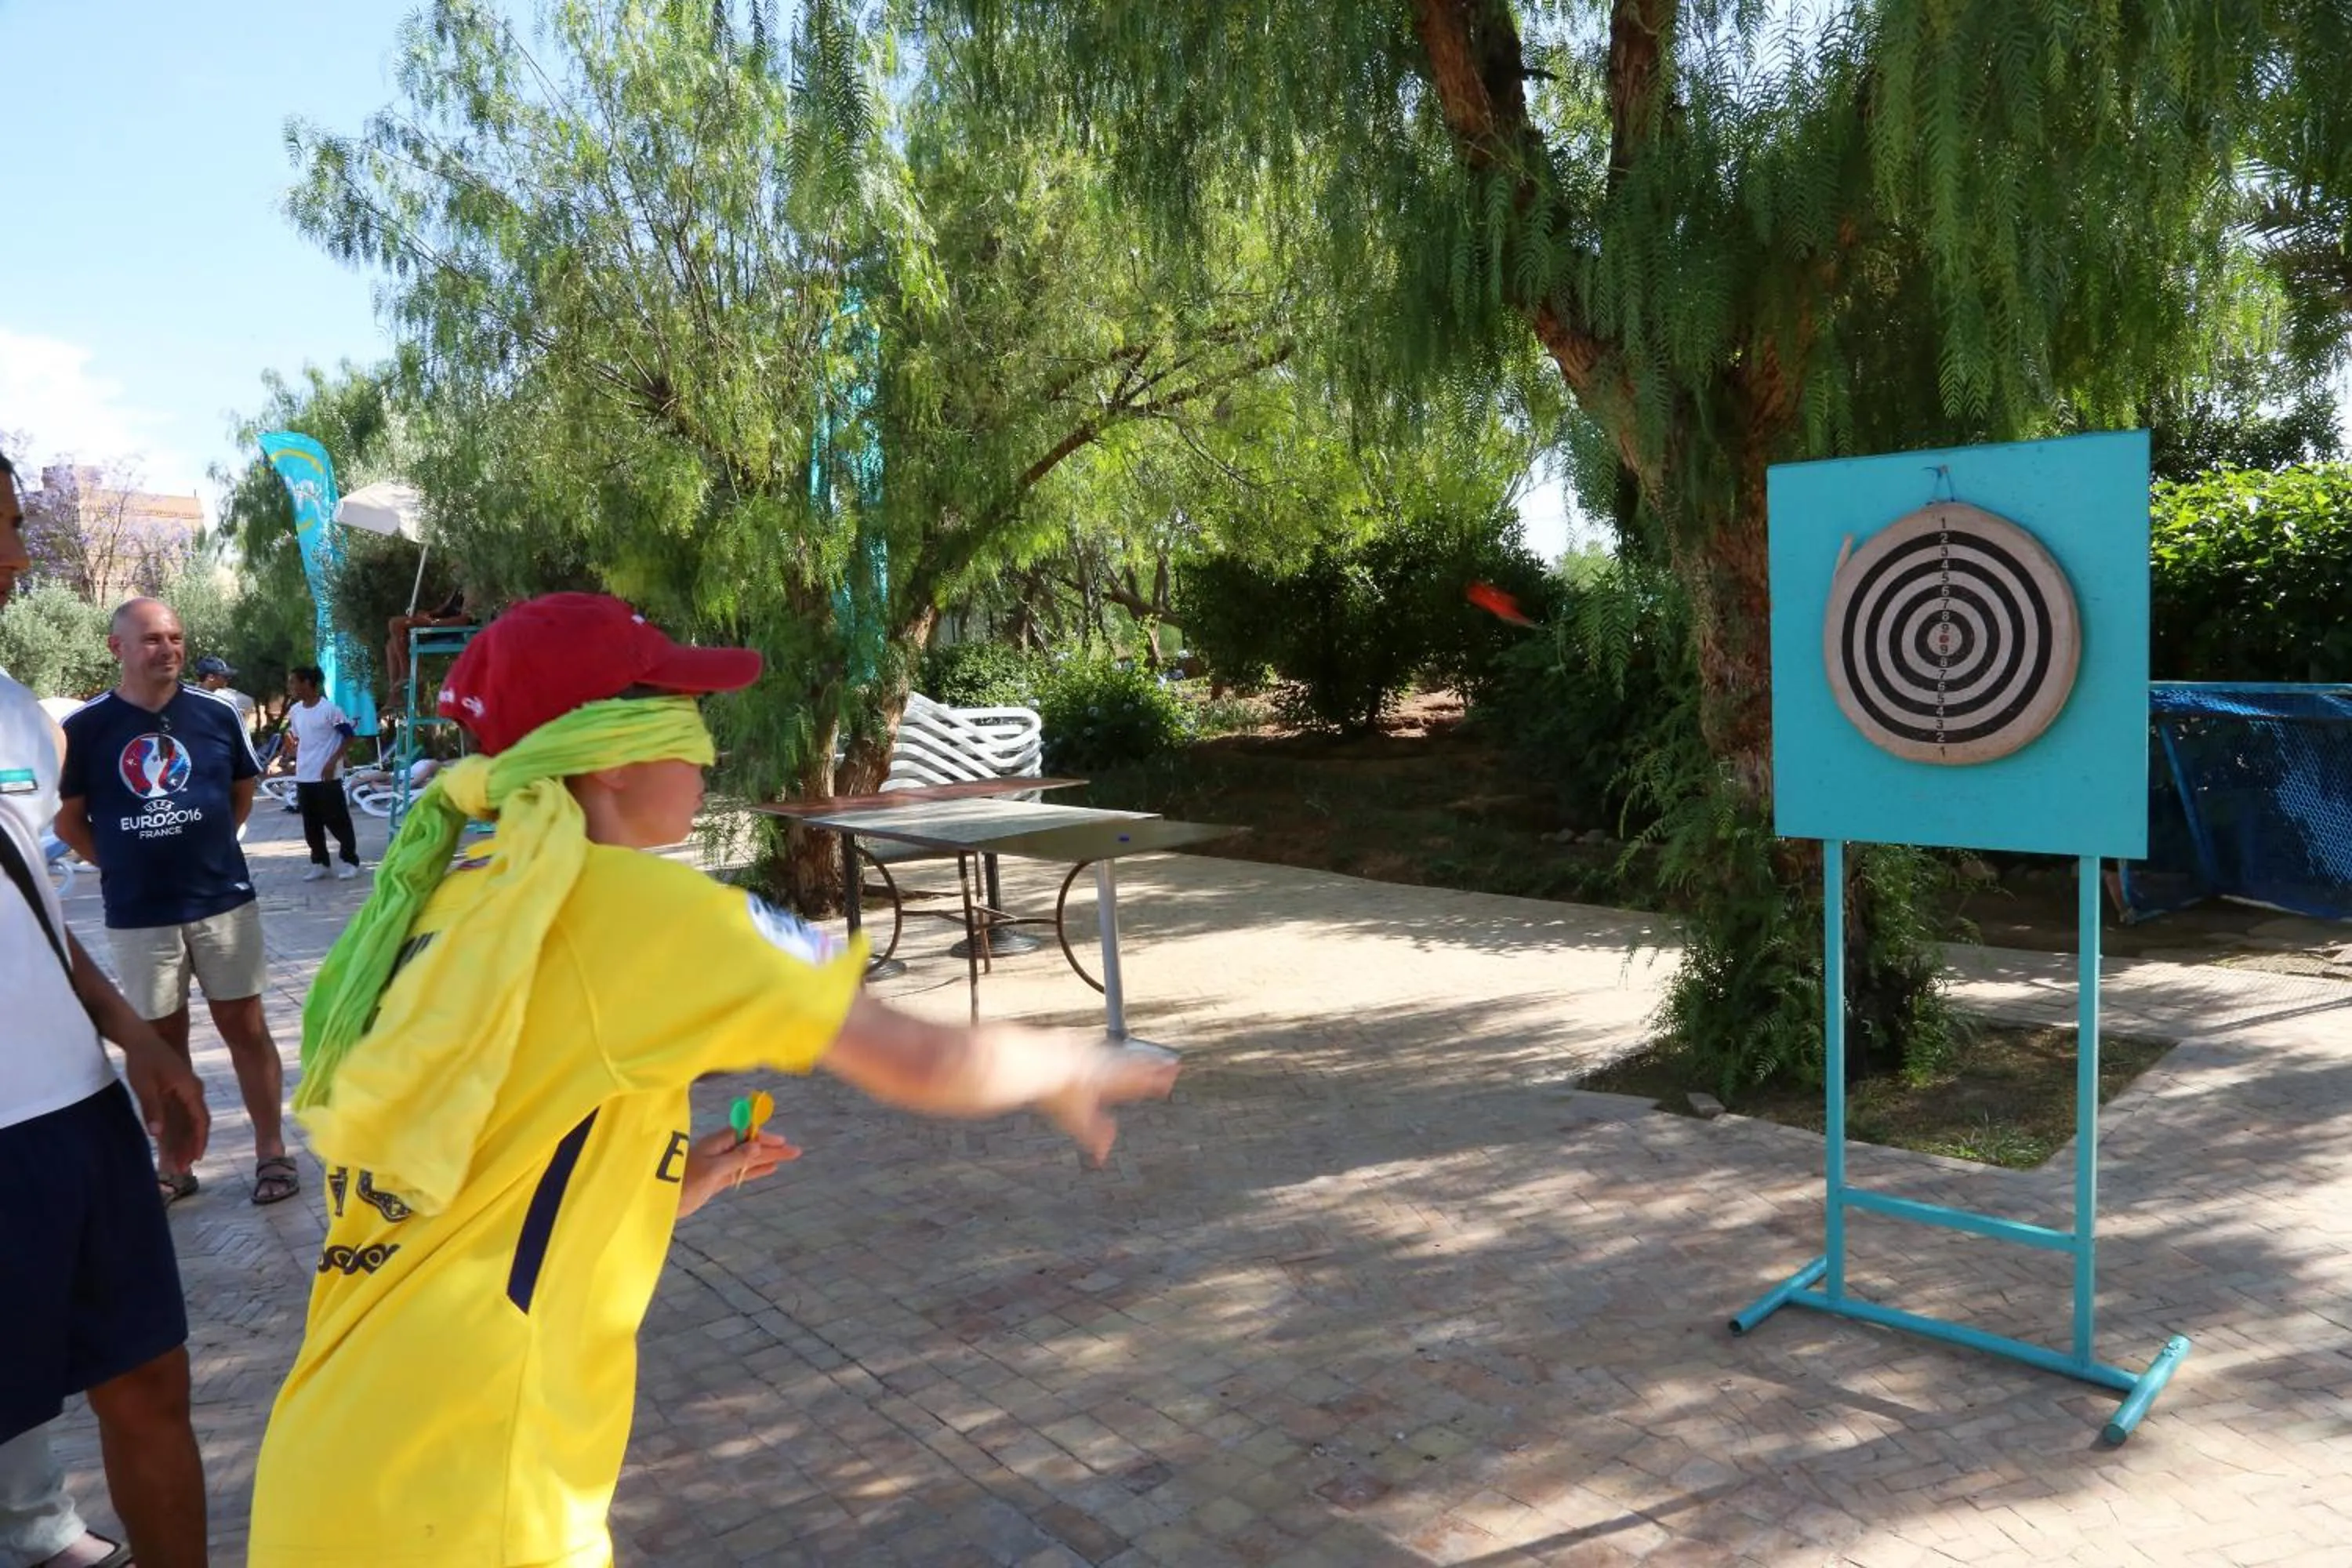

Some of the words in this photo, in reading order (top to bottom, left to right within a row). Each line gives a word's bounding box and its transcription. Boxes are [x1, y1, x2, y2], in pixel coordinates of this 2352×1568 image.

[1940, 532, 1949, 543] 2
[1940, 546, 1948, 557] 3
[1941, 559, 1948, 570] 4
[1941, 572, 1949, 583] 5
[1941, 586, 1950, 596] 6
[1940, 598, 1950, 609] 7
[1941, 611, 1950, 621] 8
[1941, 623, 1949, 633] 9
[1940, 644, 1948, 654] 9
[1940, 656, 1948, 666] 8
[1939, 669, 1947, 680] 7
[1937, 681, 1945, 691] 6
[1937, 693, 1944, 704] 5
[1936, 706, 1944, 717] 4
[1936, 719, 1944, 729] 3
[1936, 731, 1945, 742] 2
[139, 826, 183, 840] FRANCE
